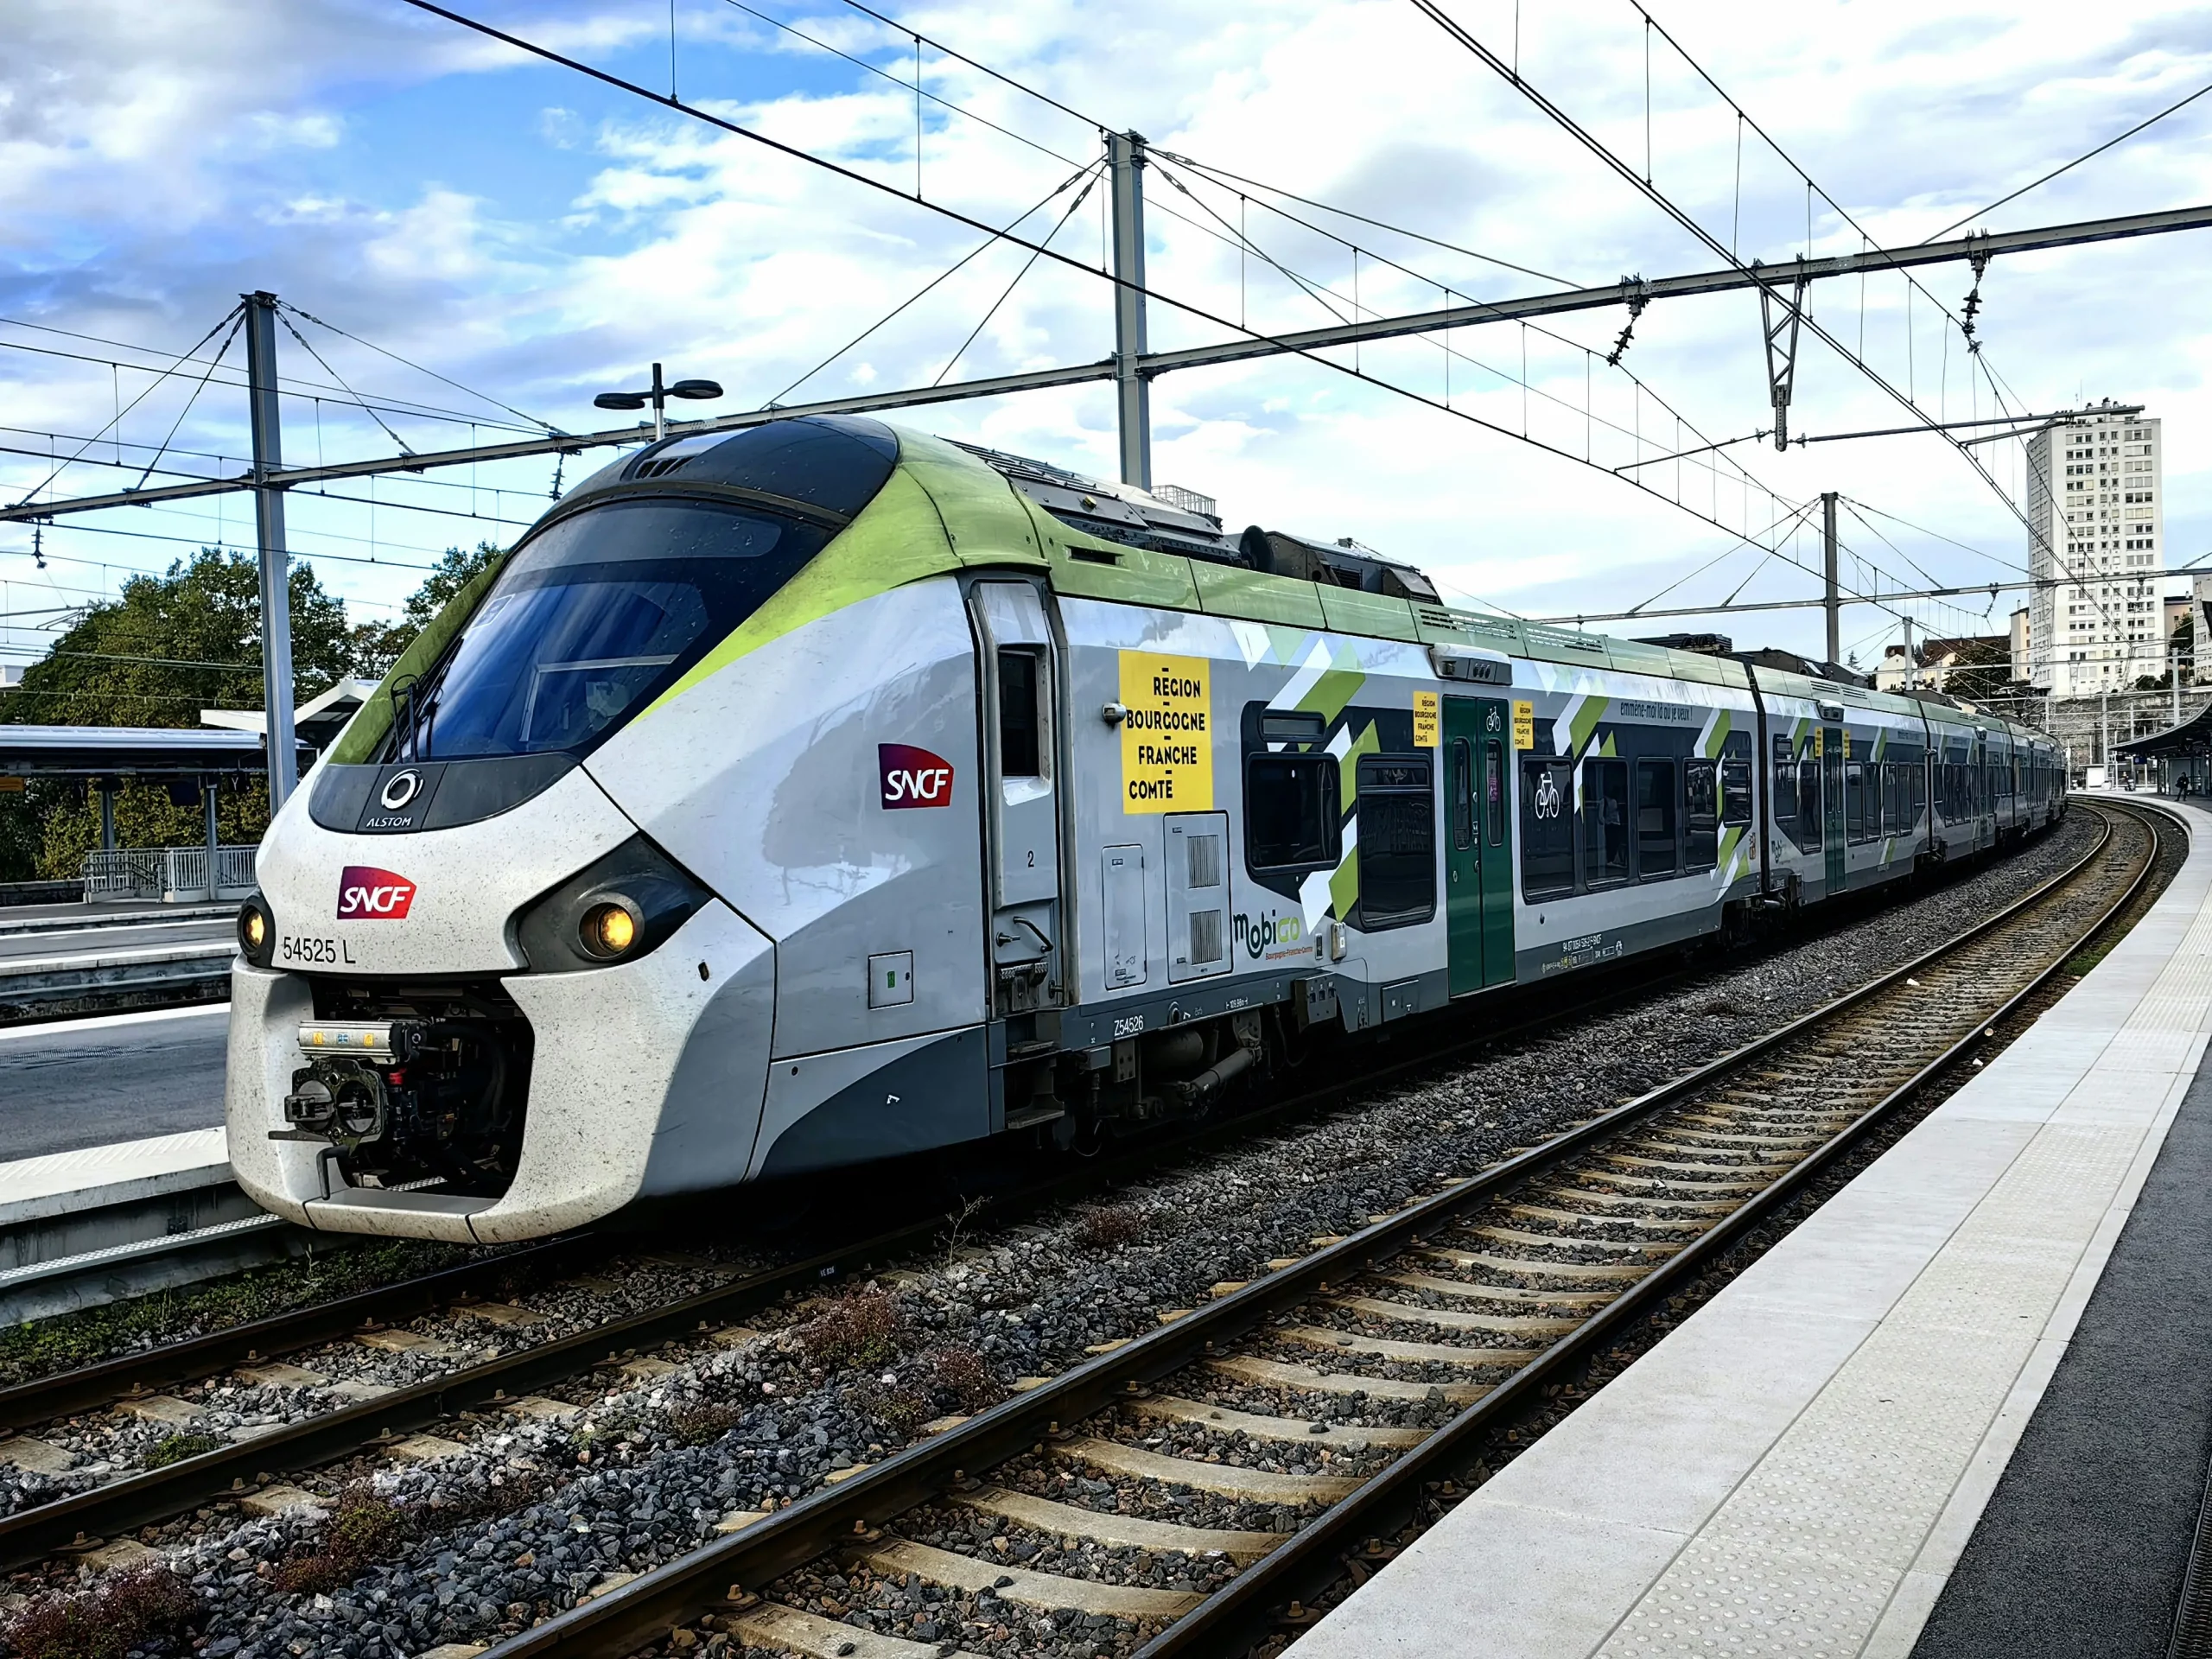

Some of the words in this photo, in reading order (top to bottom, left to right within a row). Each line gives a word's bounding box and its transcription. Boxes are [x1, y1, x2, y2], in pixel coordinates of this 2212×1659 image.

[1127, 709, 1205, 731] BOURGOGNE
[1138, 746, 1197, 765] FRANCHE
[885, 769, 949, 800] SNCF
[366, 817, 411, 827] ALSTOM
[1027, 850, 1034, 868] 2
[340, 886, 410, 912] SNCF
[283, 937, 336, 963] 54525
[343, 939, 356, 963] L
[1114, 1015, 1143, 1036] Z54526
